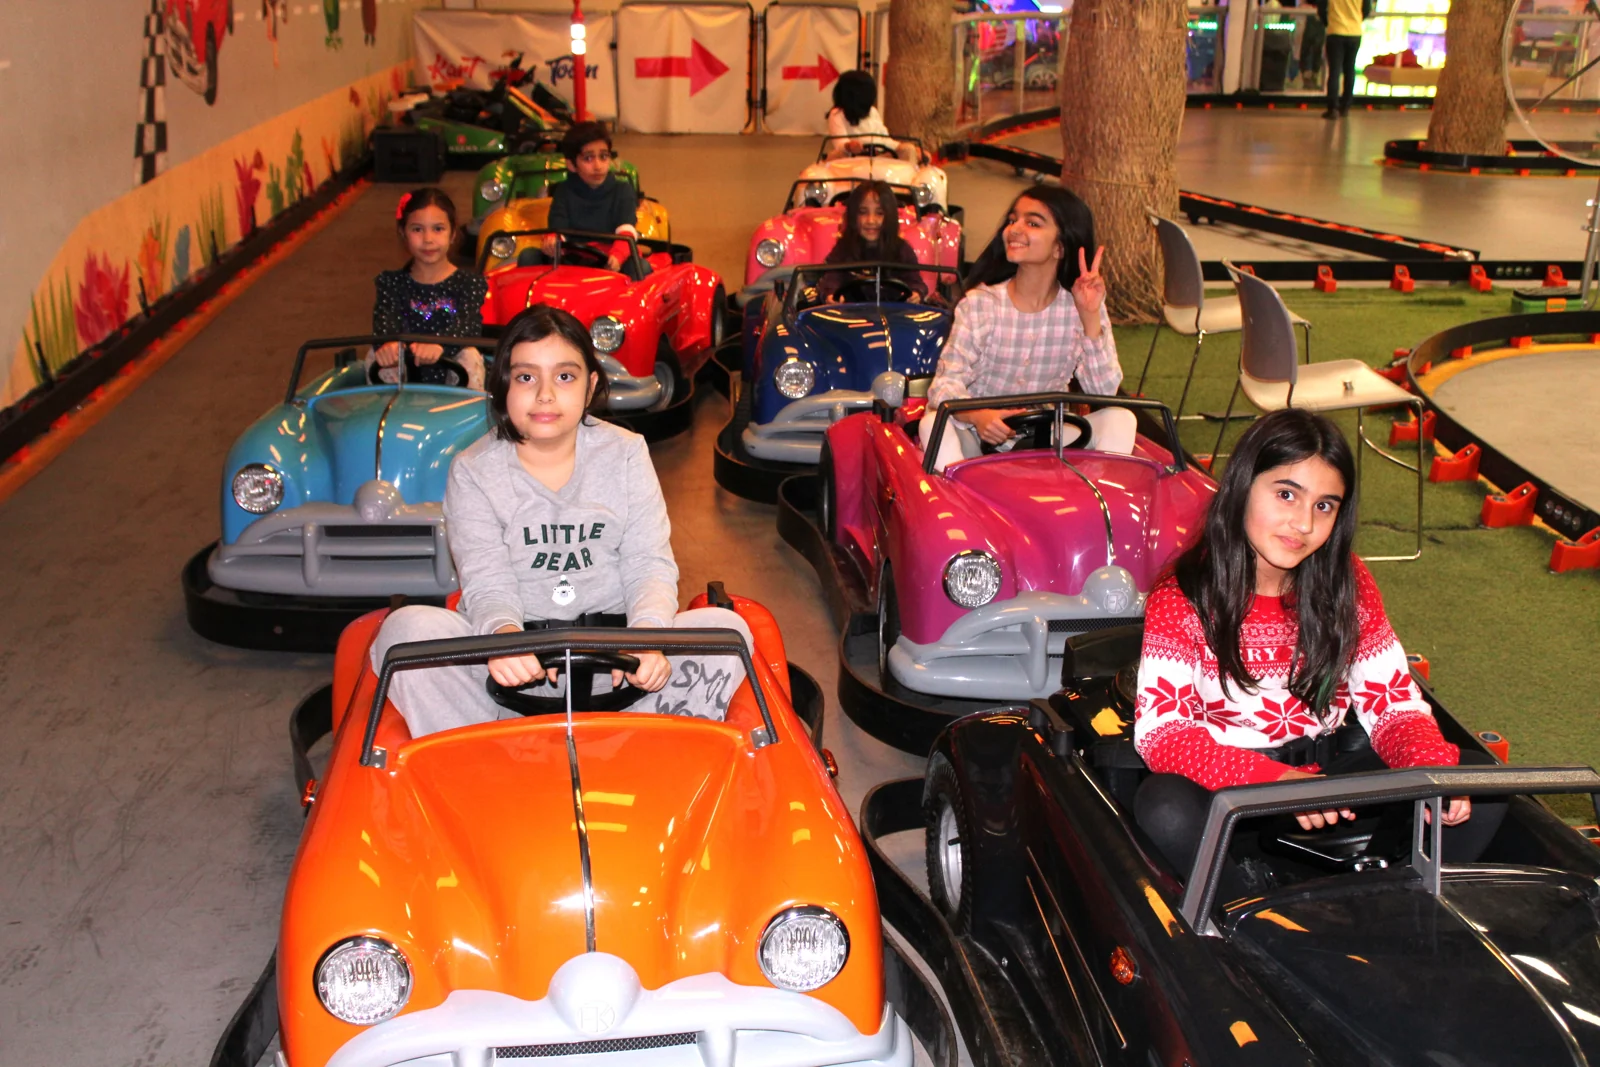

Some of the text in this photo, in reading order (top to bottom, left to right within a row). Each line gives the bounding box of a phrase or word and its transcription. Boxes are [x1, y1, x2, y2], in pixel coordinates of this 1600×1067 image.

[523, 523, 605, 545] LITTLE
[531, 548, 593, 571] BEAR
[1203, 646, 1278, 662] MRY
